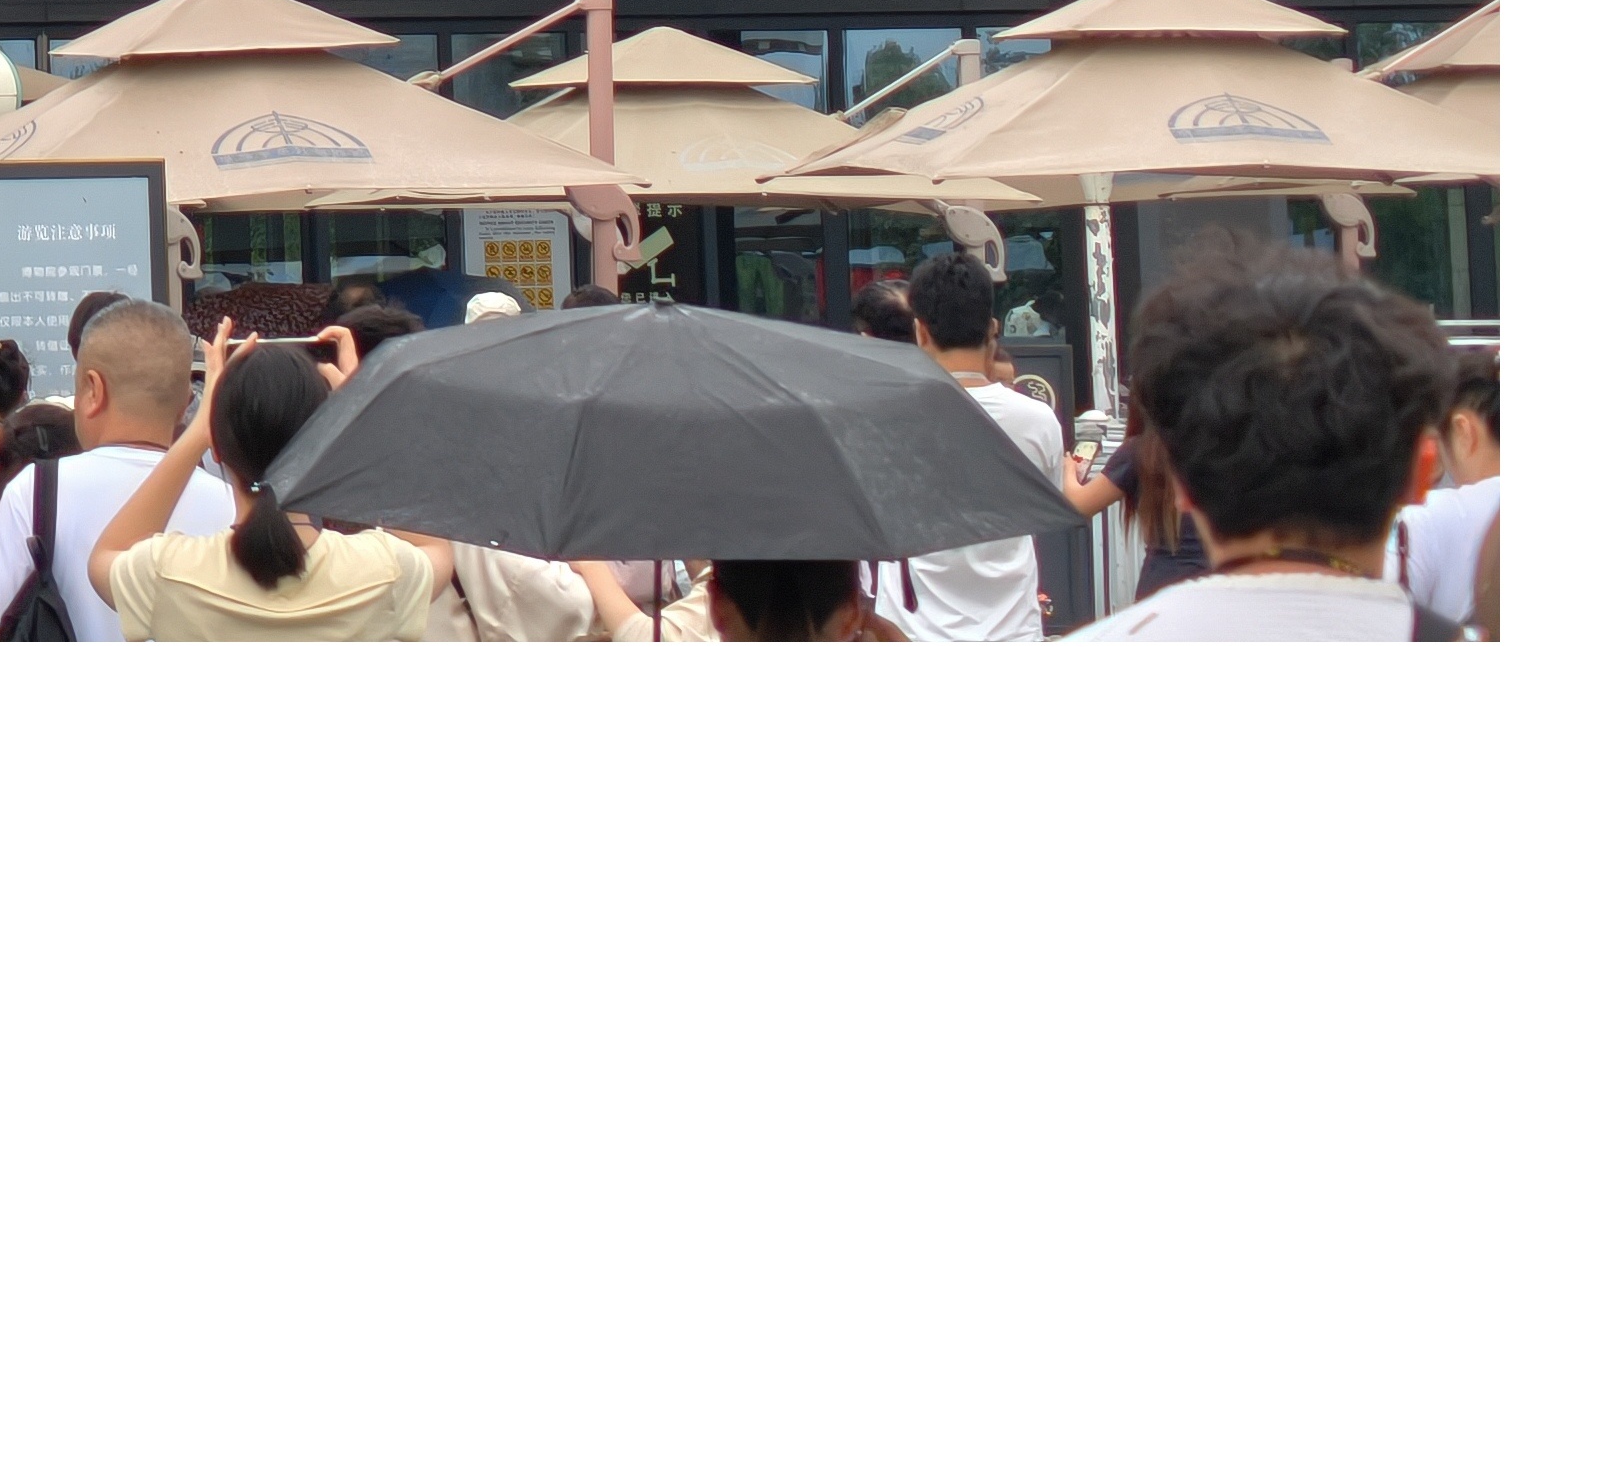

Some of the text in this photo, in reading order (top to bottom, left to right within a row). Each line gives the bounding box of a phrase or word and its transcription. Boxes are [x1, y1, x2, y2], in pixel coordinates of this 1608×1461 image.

[17, 224, 116, 241] 游览注意事项
